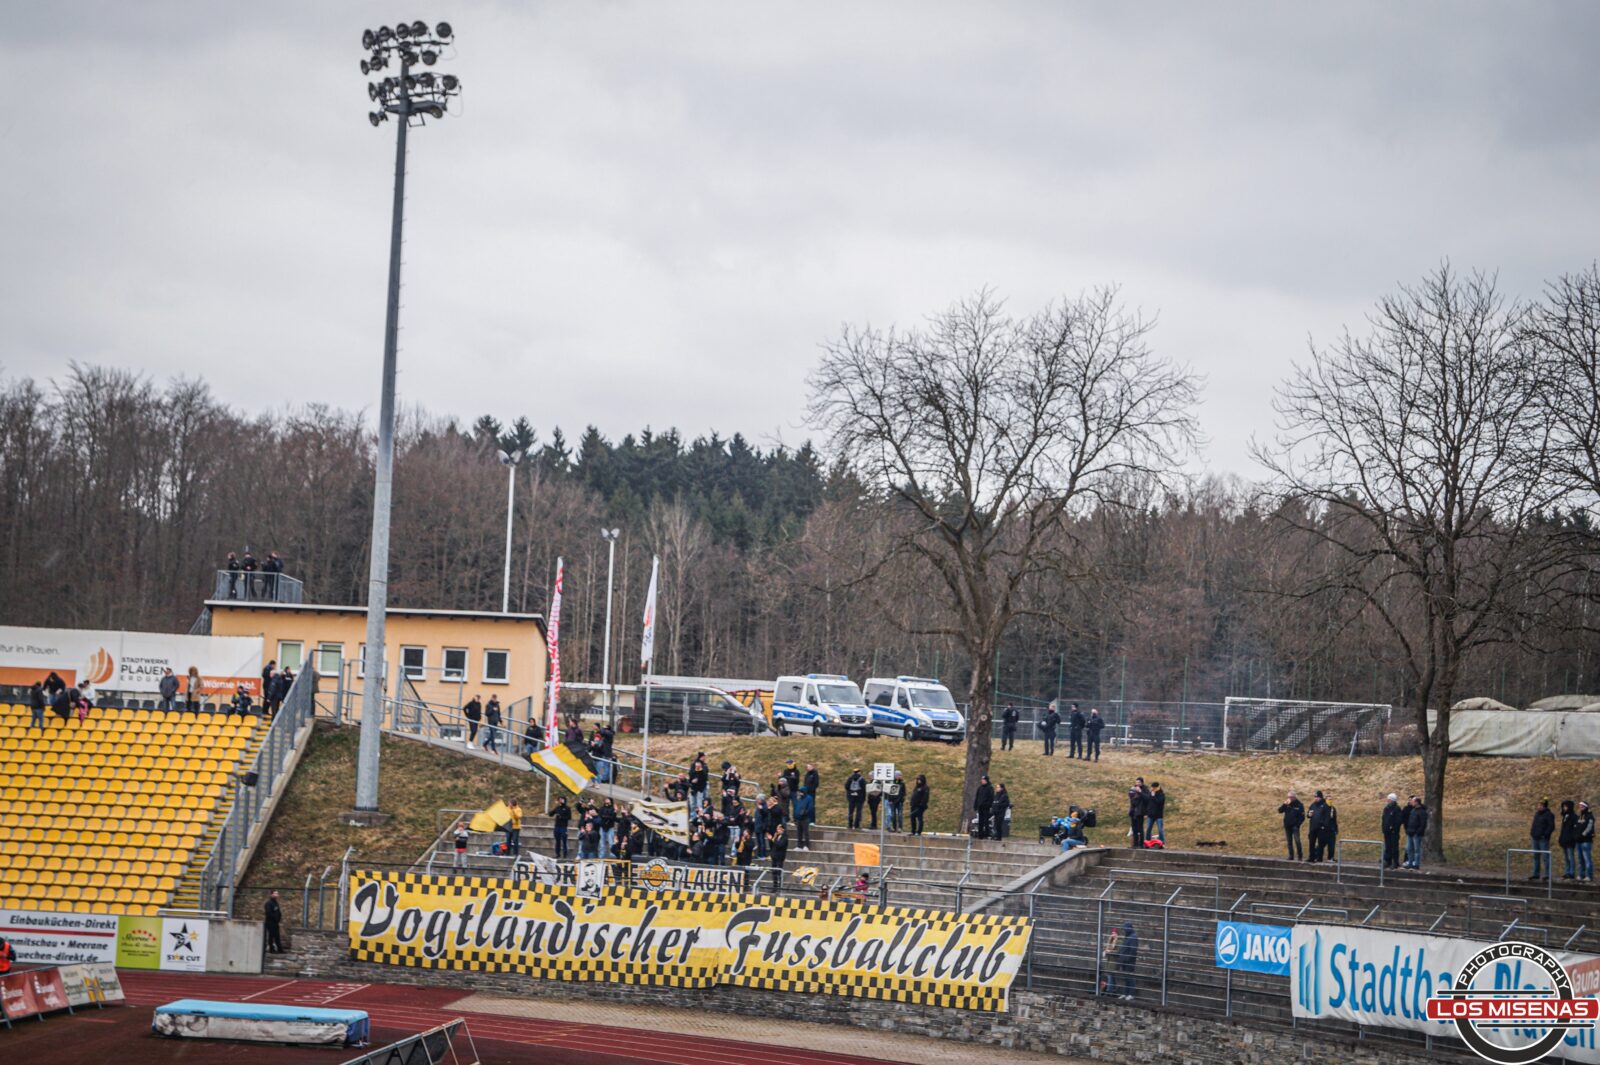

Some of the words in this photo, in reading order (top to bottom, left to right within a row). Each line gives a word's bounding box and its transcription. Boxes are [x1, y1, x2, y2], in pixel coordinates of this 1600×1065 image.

[672, 867, 742, 893] PLAUEN
[10, 914, 117, 930] Einbauküchen-Direkt
[354, 881, 701, 963] Vogtländischer
[725, 907, 1012, 984] Fussballclub
[17, 951, 98, 963] uechen-direkt.de
[67, 939, 108, 950] Meerane
[1243, 933, 1290, 964] JAKO
[1329, 943, 1476, 1026] Stadtba
[1571, 966, 1600, 994] Sauna
